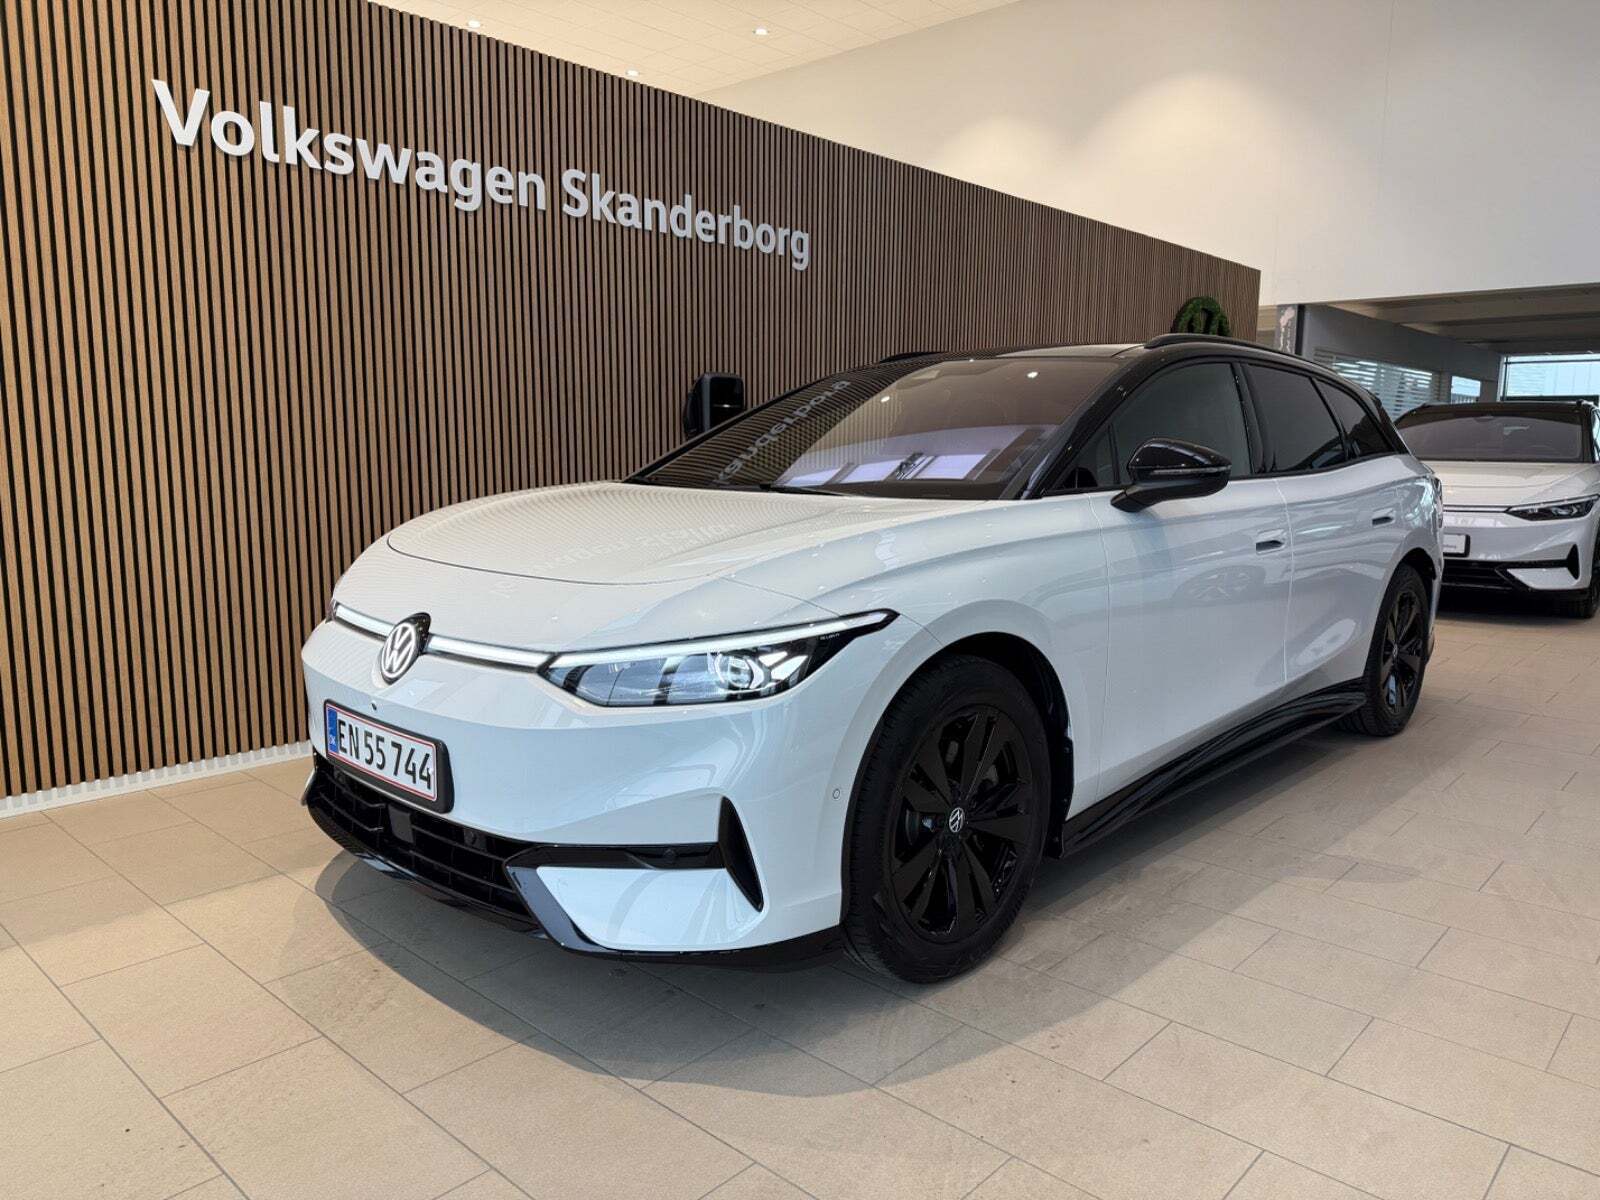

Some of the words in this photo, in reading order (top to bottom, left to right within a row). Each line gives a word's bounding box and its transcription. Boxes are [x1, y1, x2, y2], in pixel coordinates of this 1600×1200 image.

[152, 78, 546, 212] Volkswagen
[561, 169, 810, 271] Skanderborg
[381, 622, 417, 679] VW
[338, 719, 359, 760] EN
[364, 731, 387, 770] 55
[391, 740, 431, 790] 744
